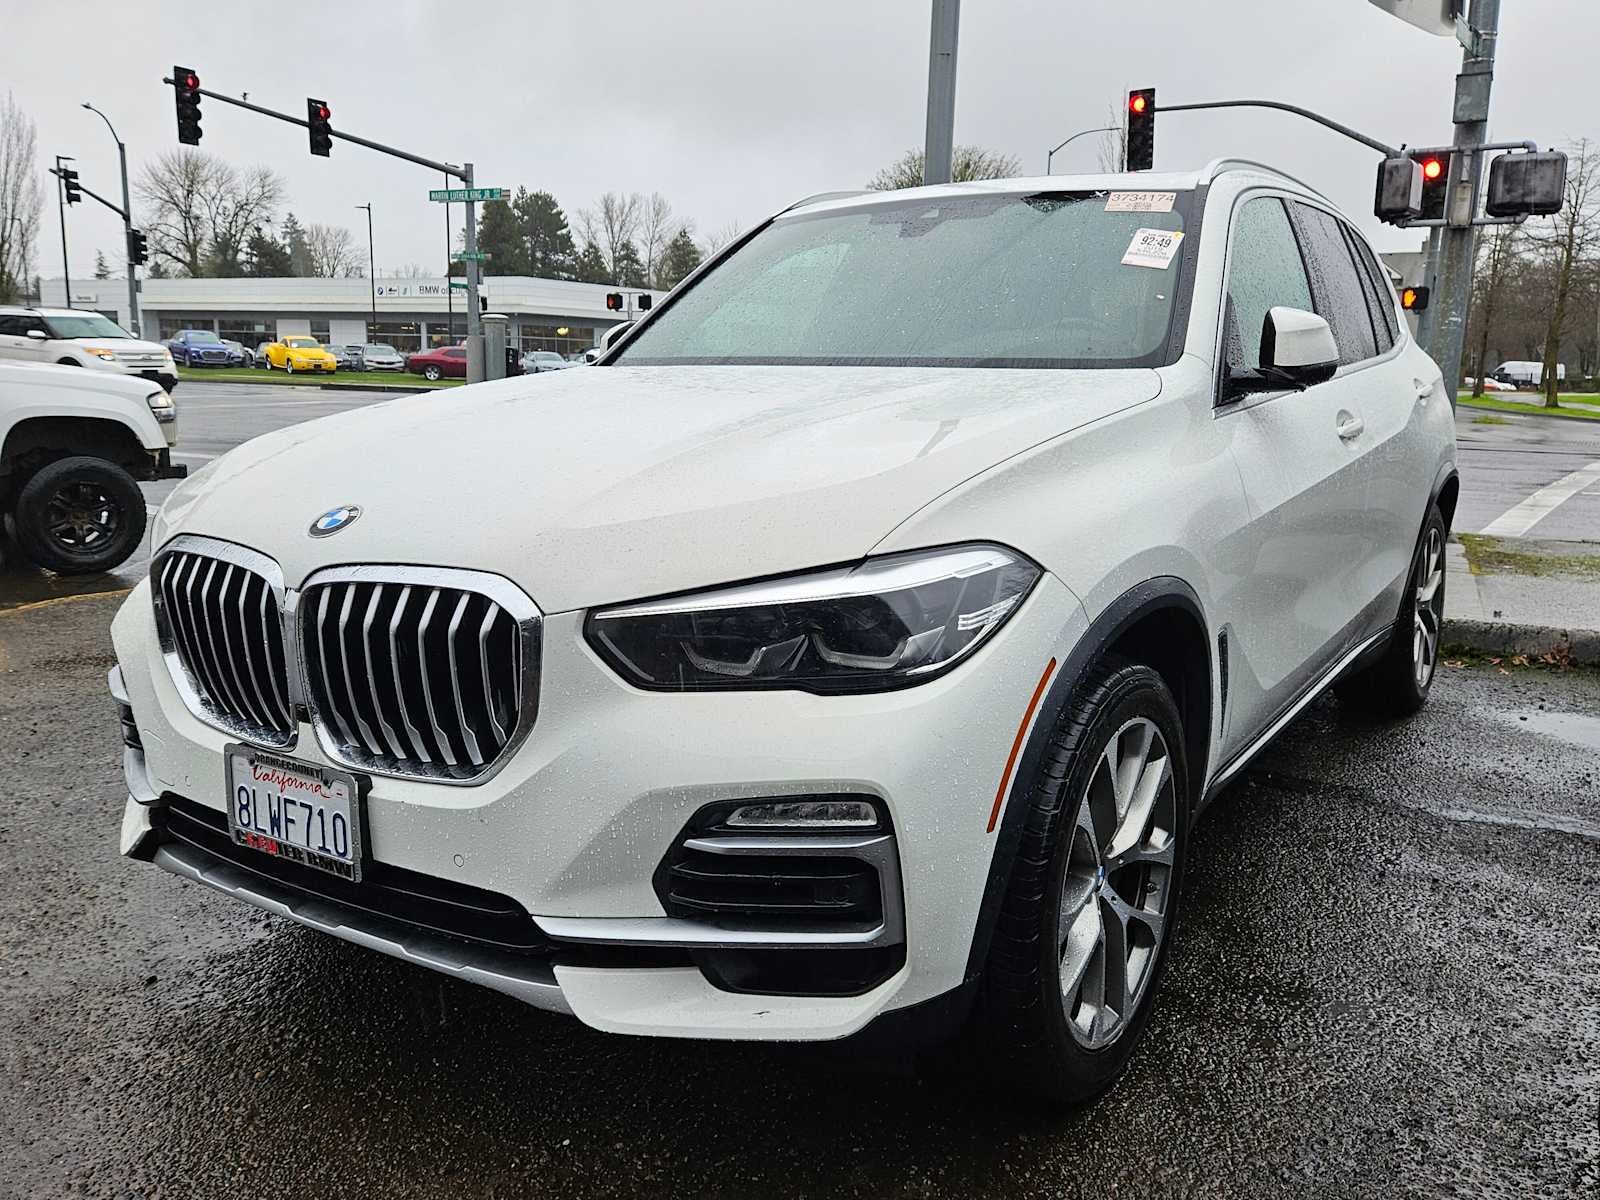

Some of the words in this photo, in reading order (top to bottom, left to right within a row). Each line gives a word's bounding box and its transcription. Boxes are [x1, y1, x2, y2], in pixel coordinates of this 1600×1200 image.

[450, 190, 469, 201] LUTHER
[1111, 193, 1174, 202] 3734174
[1140, 235, 1172, 248] 92:49
[419, 285, 440, 295] BMW
[251, 764, 332, 799] California
[237, 784, 348, 858] 8LWF710
